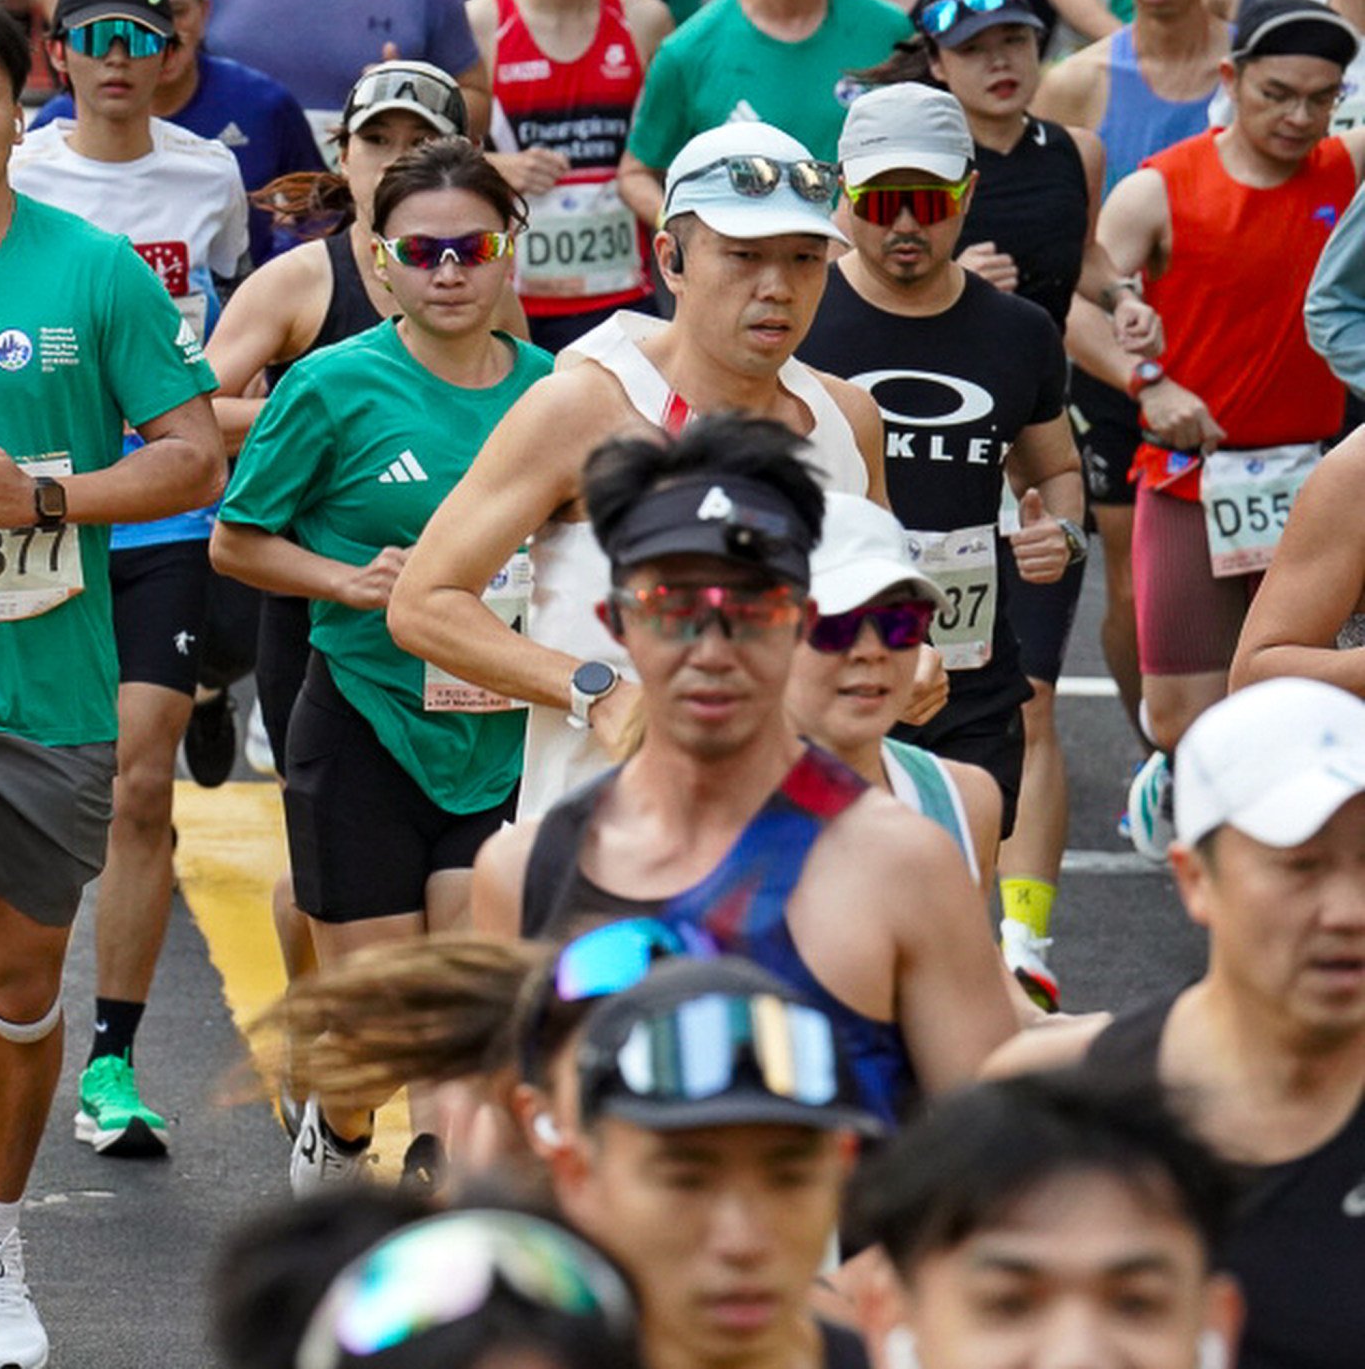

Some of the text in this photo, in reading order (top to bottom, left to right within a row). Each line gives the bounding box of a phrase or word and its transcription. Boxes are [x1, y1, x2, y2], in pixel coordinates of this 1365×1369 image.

[527, 222, 631, 266] D0230
[1212, 491, 1302, 538] D55
[938, 584, 988, 630] 37
